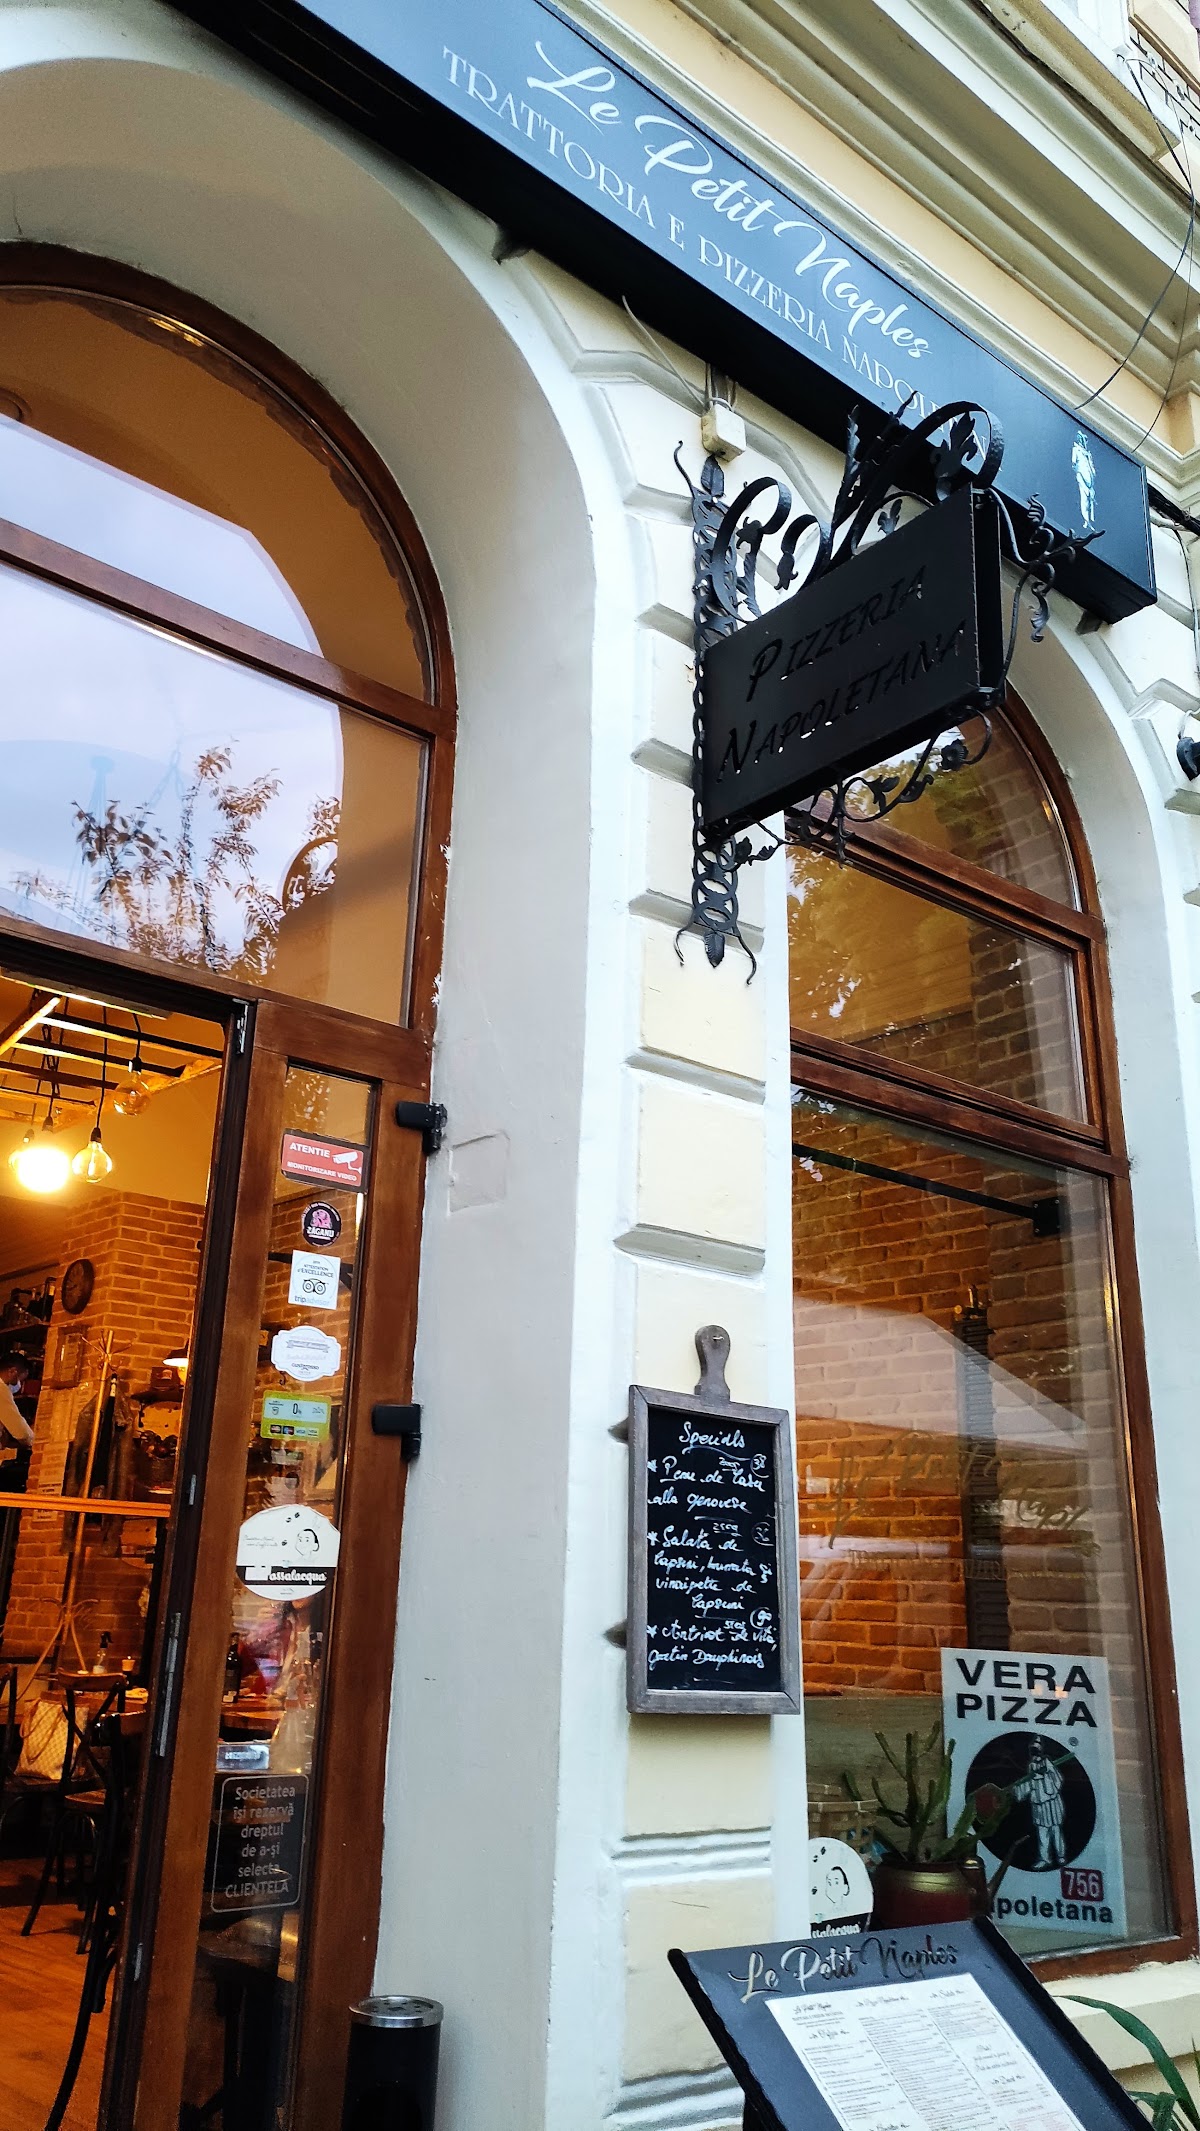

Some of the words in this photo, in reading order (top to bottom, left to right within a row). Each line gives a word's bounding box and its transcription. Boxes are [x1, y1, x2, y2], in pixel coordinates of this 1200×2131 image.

[443, 45, 656, 229] TRATTORIA
[668, 213, 685, 250] E
[698, 234, 832, 351] PIZZERIA
[527, 40, 622, 136] Le
[634, 115, 778, 231] Petit
[774, 220, 932, 358] Naples
[746, 565, 926, 702] PIZZERIA
[716, 619, 966, 782] NAPOLETANA
[290, 1142, 330, 1158] ATENTIE
[286, 1161, 336, 1177] MONITORIZARE
[336, 1171, 357, 1181] VIDEO
[679, 1421, 745, 1449] Specials
[700, 1471, 725, 1484] de
[719, 1539, 744, 1552] de
[252, 1567, 327, 1585] assalacqua
[731, 1581, 757, 1593] de
[955, 1658, 1096, 1694] VERA
[956, 1693, 1098, 1728] PIZZA
[235, 1785, 295, 1801] Societatea
[250, 1803, 294, 1819] rezervă
[241, 1823, 284, 1840] dreptul
[241, 1844, 257, 1858] de
[238, 1862, 280, 1878] selecta
[225, 1882, 289, 1898] CLIENTELA
[1065, 1870, 1099, 1898] 756
[992, 1895, 1114, 1924] poletana
[728, 1950, 783, 2003] Le
[781, 1945, 858, 1991] Petit
[860, 1934, 958, 1979] Naples
